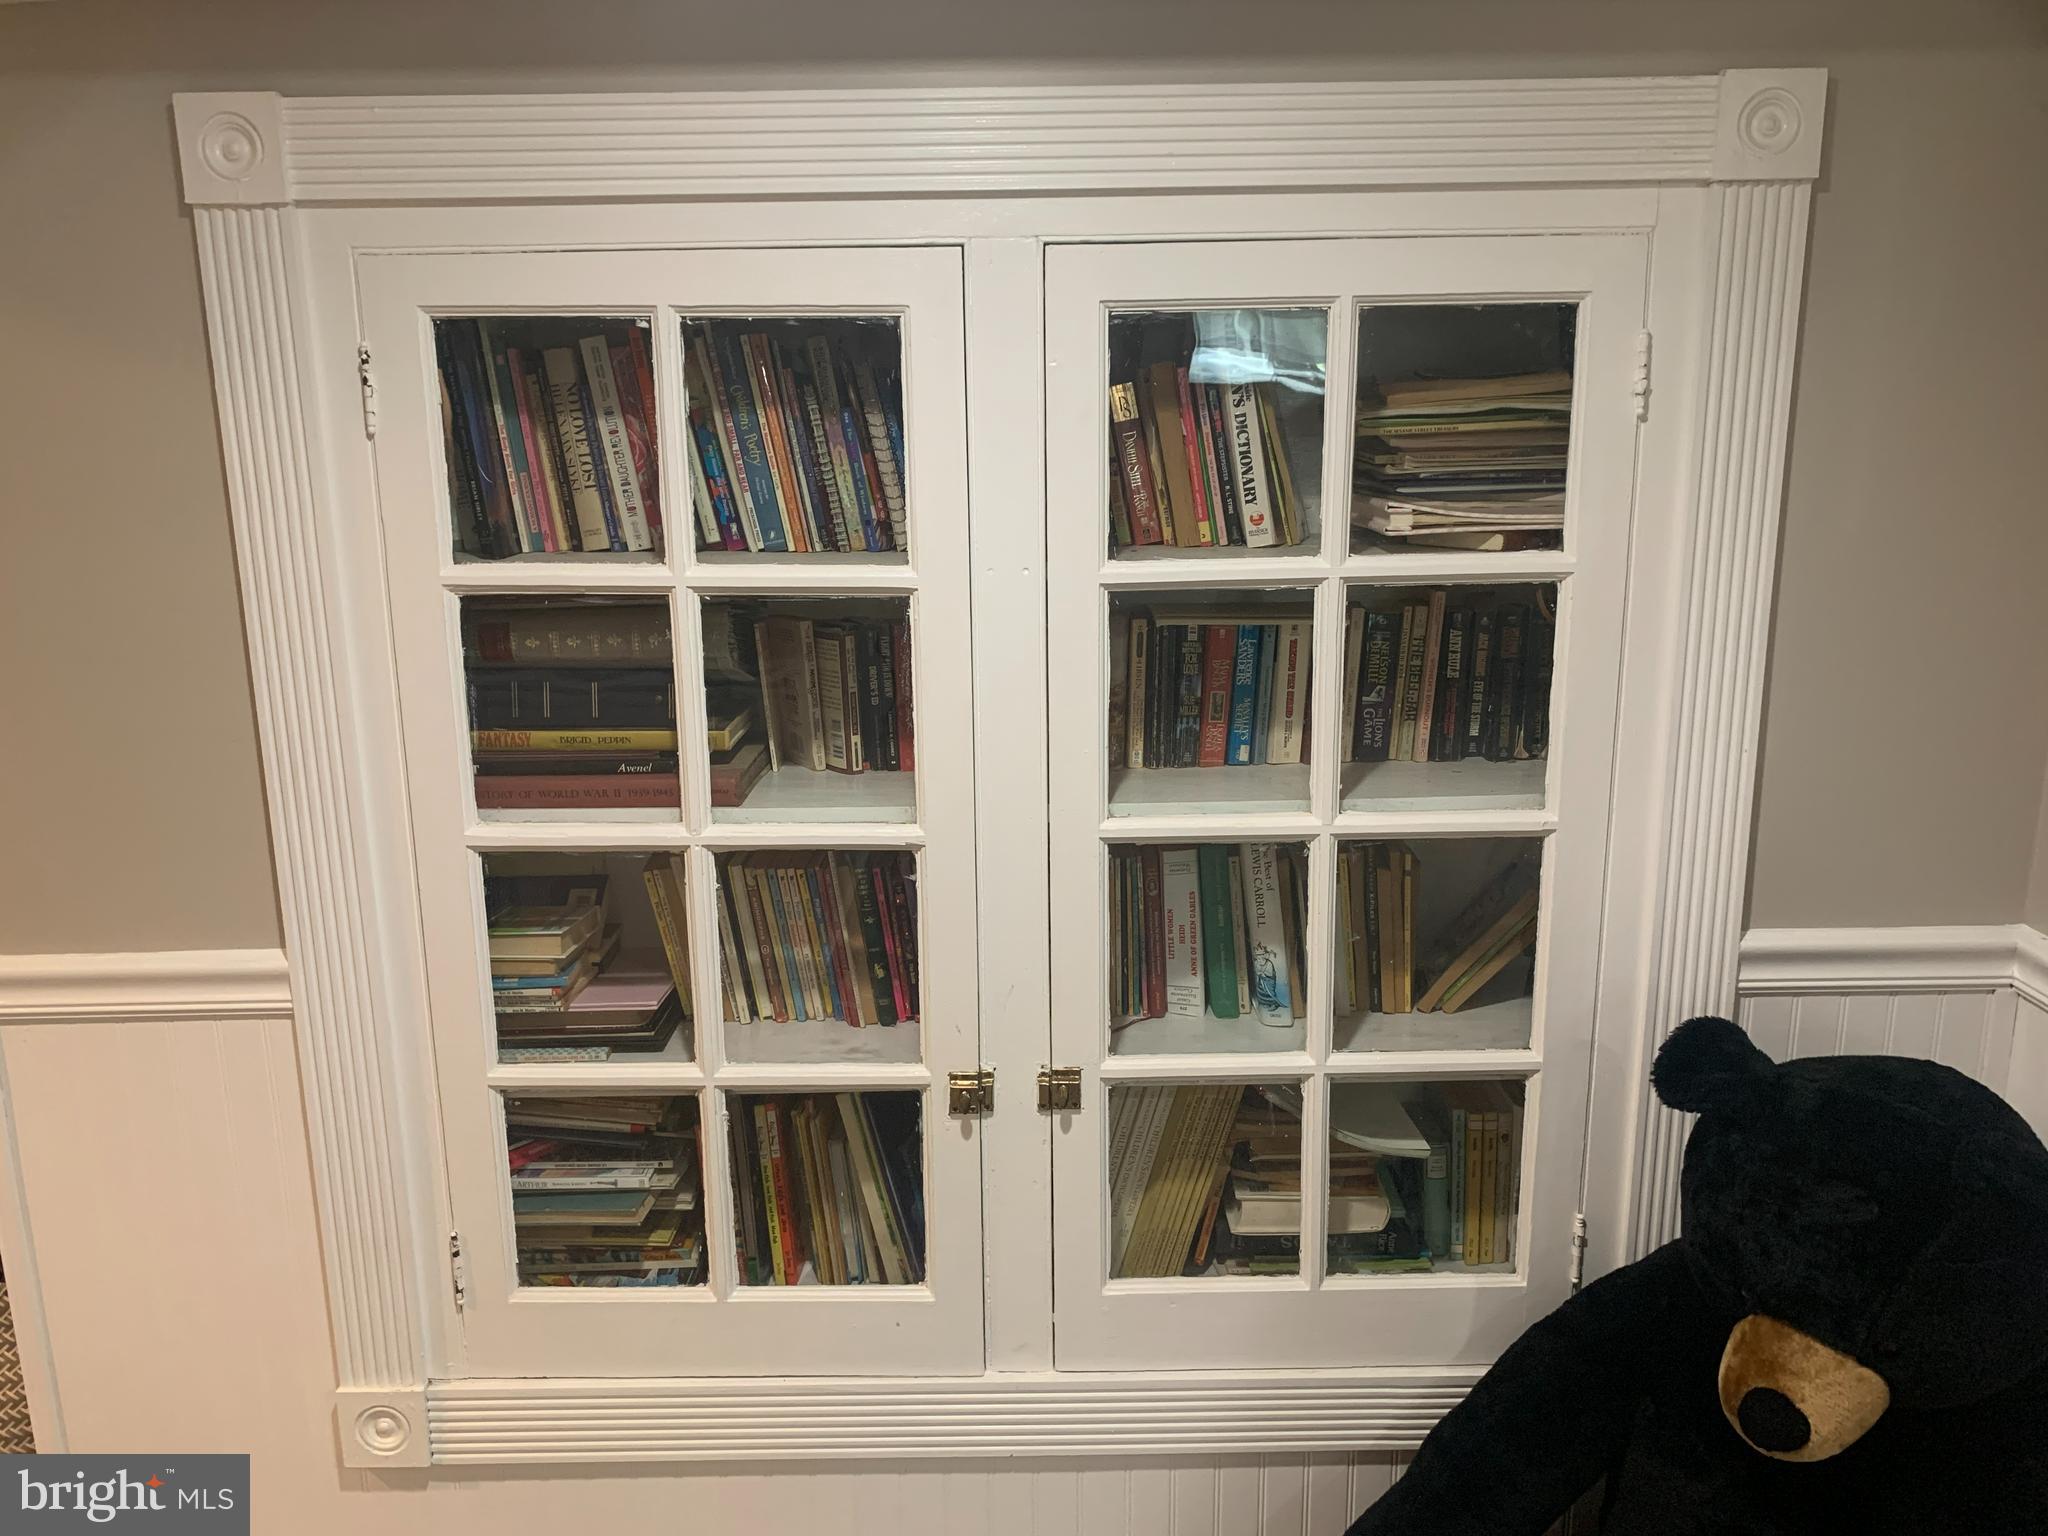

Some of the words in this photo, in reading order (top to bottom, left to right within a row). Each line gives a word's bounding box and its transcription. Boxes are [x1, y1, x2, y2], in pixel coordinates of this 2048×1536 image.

[550, 384, 568, 426] HELEN
[565, 382, 579, 406] NO
[569, 409, 590, 448] LOVE
[601, 404, 622, 449] REVOLUTION
[730, 385, 752, 430] Children's
[744, 433, 762, 467] Poetry
[611, 448, 631, 487] DAUGHTER
[731, 450, 741, 462] FAR
[1234, 413, 1258, 506] DICTIONARY
[577, 454, 597, 491] LOST
[734, 463, 744, 476] AND
[1127, 464, 1143, 489] STEEL
[1218, 450, 1229, 481] STEPSISTER
[1226, 498, 1234, 514] STINE
[738, 478, 748, 494] NEAR
[620, 487, 638, 518] MOTHER
[1450, 629, 1462, 652] ANN
[1235, 639, 1247, 686] SANDERS
[1245, 639, 1256, 685] Lawrence
[1377, 641, 1390, 684] NELSON
[1447, 653, 1460, 678] RULE
[868, 666, 879, 696] DRIVER'S
[1473, 681, 1484, 693] EYE
[871, 697, 880, 706] ED
[1471, 703, 1481, 713] THE
[1472, 694, 1482, 702] OF
[1233, 703, 1243, 736] SECRET
[1422, 694, 1433, 731] BURNOUT
[1469, 714, 1480, 736] STORM
[478, 732, 531, 747] FANTASY
[1362, 708, 1373, 746] GAME
[1373, 718, 1386, 747] LION'S
[559, 736, 592, 744] BRIGID
[598, 736, 632, 744] PEPPIN
[618, 763, 652, 772] Avenel
[518, 790, 533, 799] OF
[539, 790, 579, 799] WORLD
[583, 790, 609, 798] WAR
[615, 789, 621, 797] II
[1263, 861, 1273, 880] Best
[1264, 883, 1276, 892] of
[1254, 879, 1266, 928] CARROLL
[1189, 920, 1197, 944] GREEN
[1190, 946, 1197, 955] OF
[1190, 957, 1198, 977] ANNE
